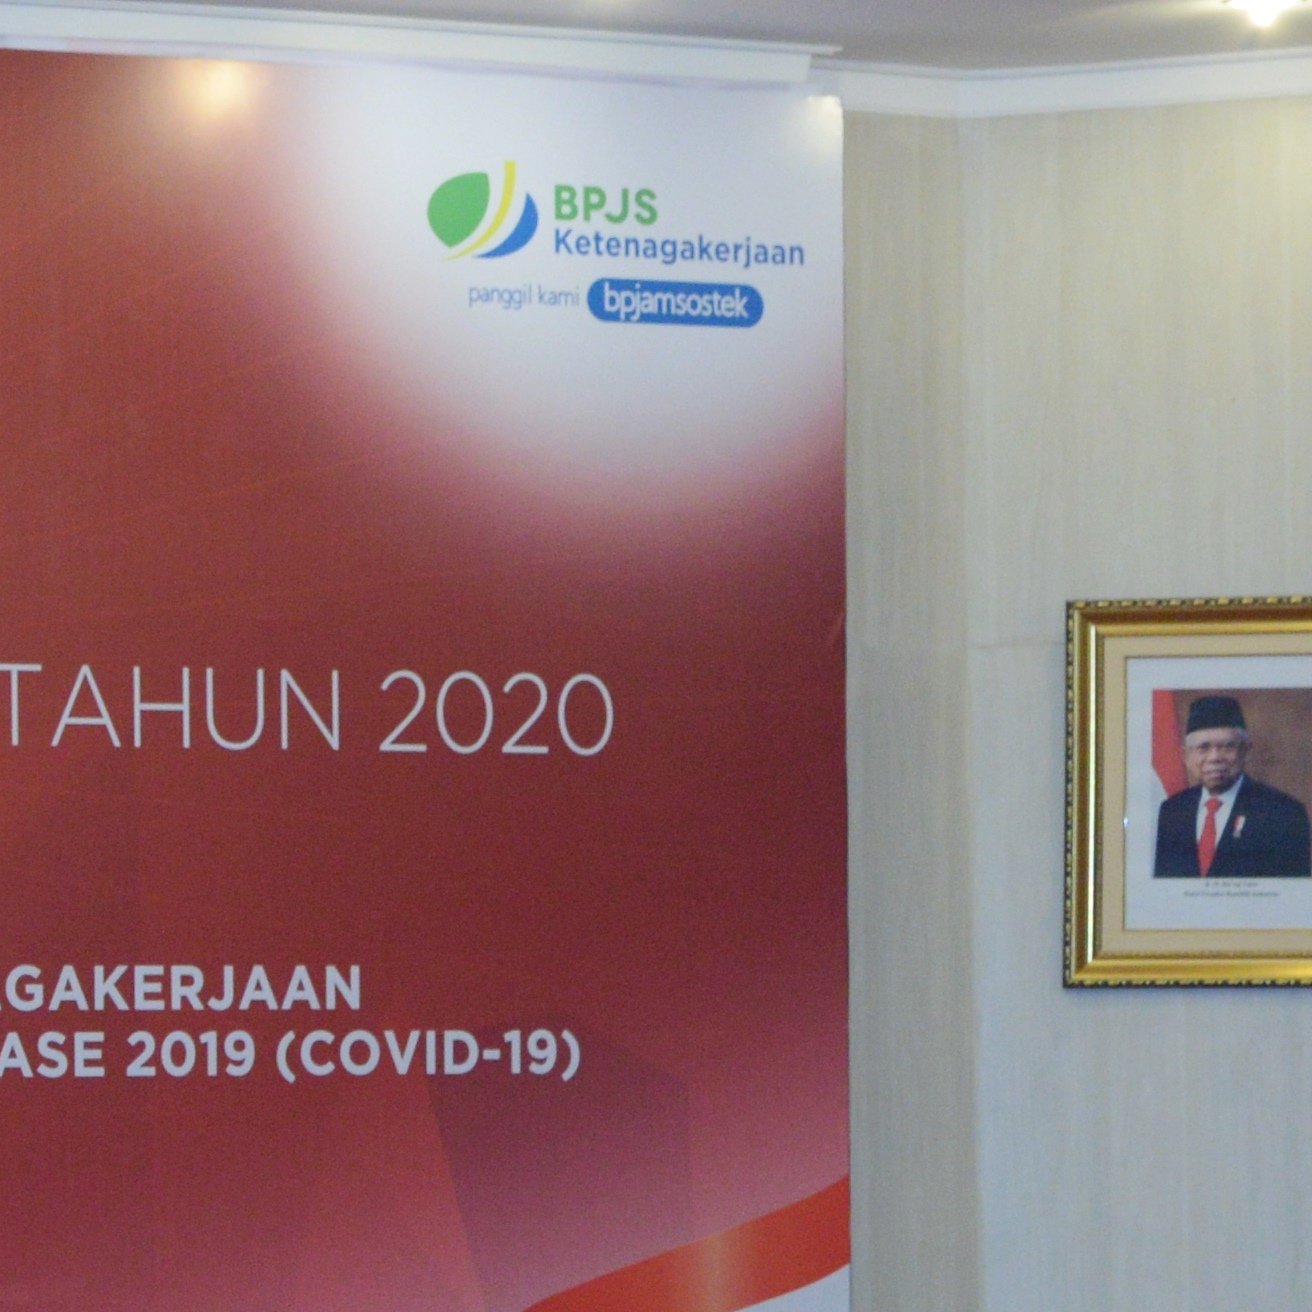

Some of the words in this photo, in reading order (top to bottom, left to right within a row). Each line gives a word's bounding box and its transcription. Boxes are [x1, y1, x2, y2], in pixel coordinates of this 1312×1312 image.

[554, 183, 658, 226] BPJS
[554, 227, 806, 269] Ketenagakerjaan
[468, 283, 533, 311] panggil
[538, 284, 580, 307] kami
[603, 280, 750, 322] bpjamsostek
[379, 668, 615, 757] 2020
[126, 1030, 255, 1078] 2019
[276, 1029, 581, 1083] (COVID-19)
